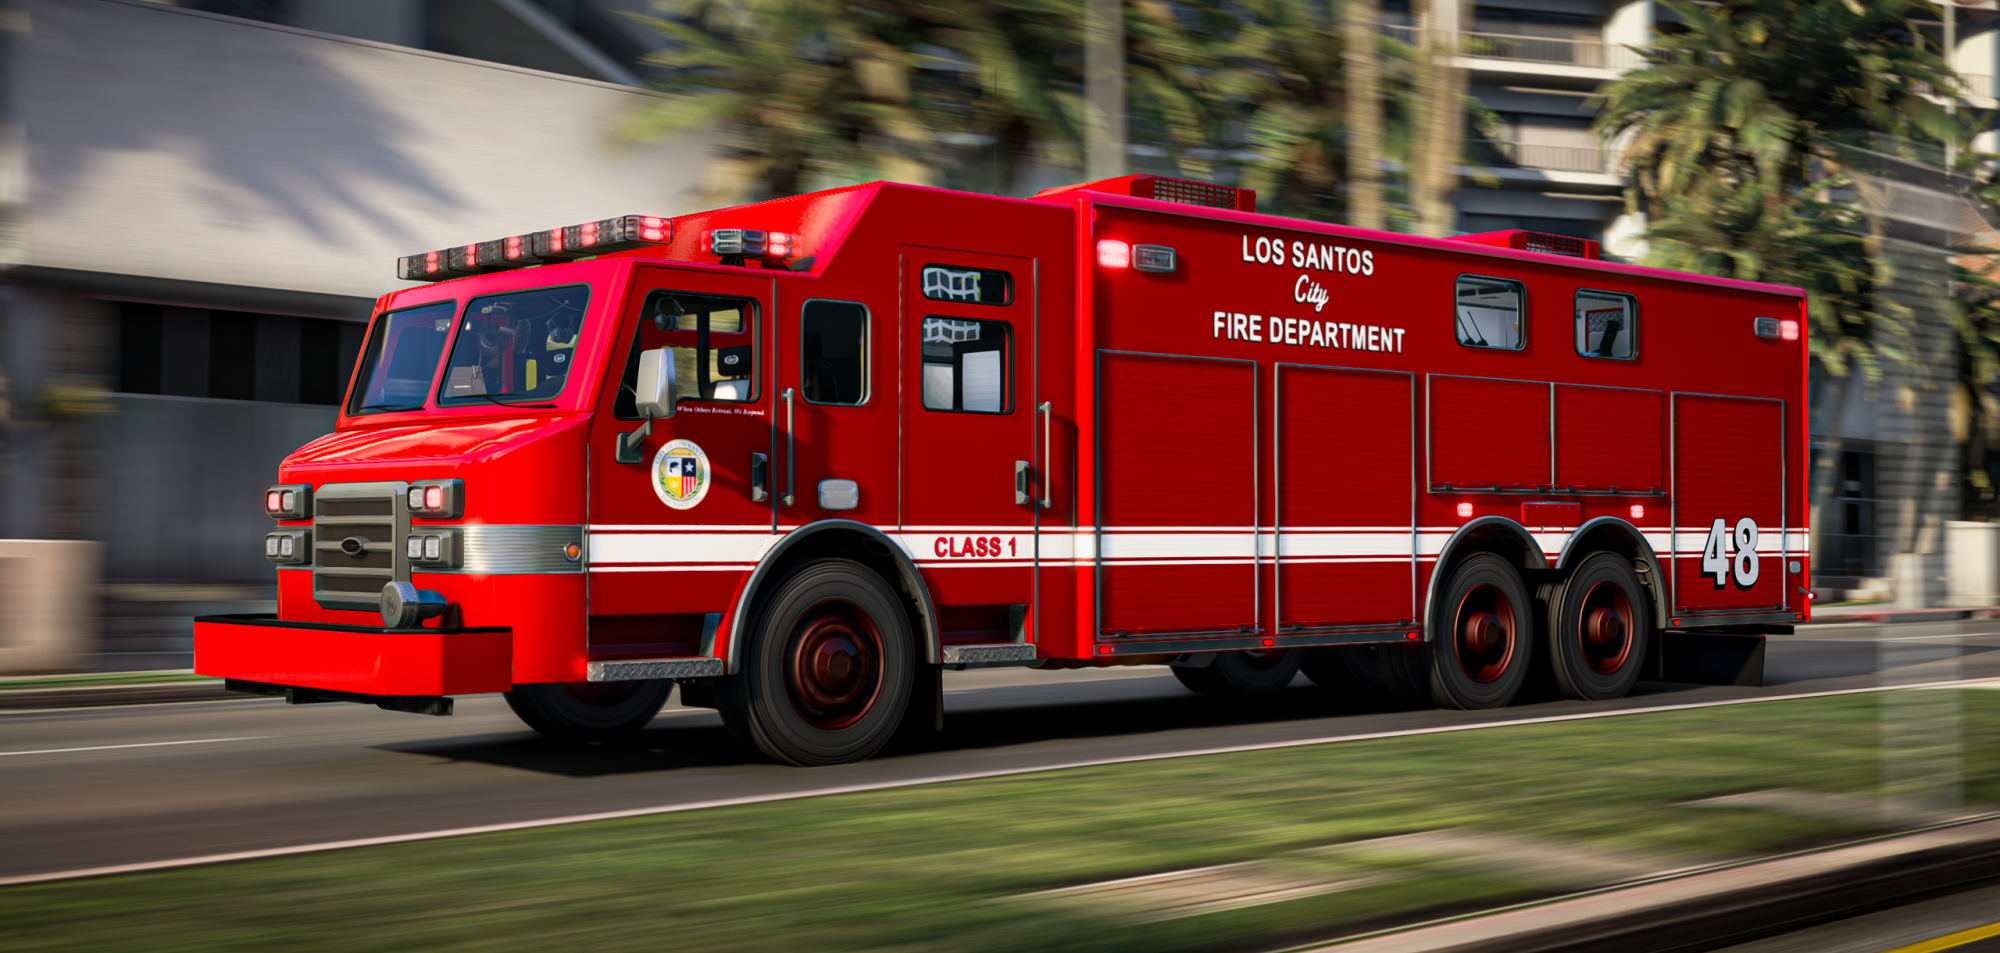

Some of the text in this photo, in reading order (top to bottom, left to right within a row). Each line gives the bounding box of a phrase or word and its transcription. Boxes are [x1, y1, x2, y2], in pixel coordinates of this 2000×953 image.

[1242, 234, 1374, 276] LOS SANTOS
[1293, 274, 1329, 313] City
[1213, 311, 1405, 353] FIRE DEPARTMENT
[934, 536, 1016, 557] CLASS 1
[1701, 517, 1760, 591] 48
